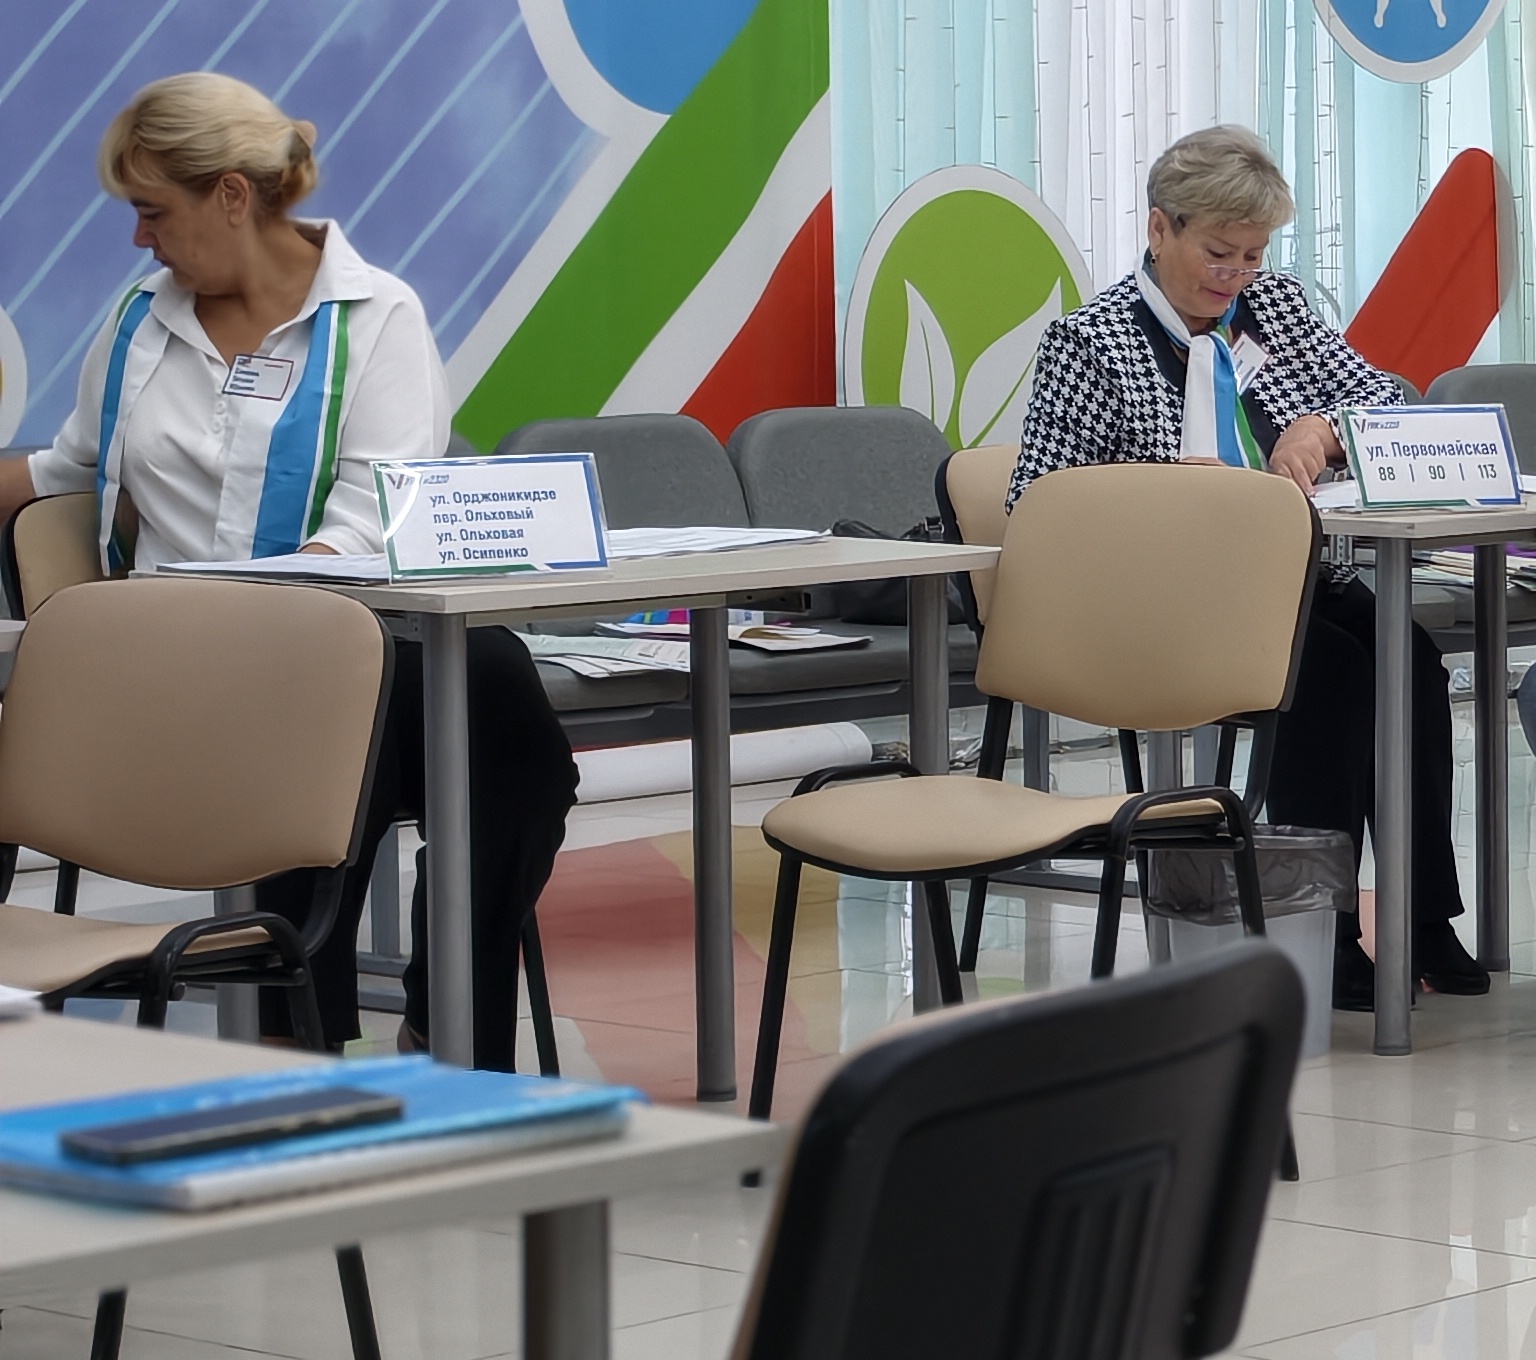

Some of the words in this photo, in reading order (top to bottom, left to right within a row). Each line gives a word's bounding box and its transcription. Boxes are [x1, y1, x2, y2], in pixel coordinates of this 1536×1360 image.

[1366, 445, 1389, 462] ул.
[1391, 439, 1498, 460] Первомайская
[1378, 465, 1396, 481] 88
[1428, 464, 1446, 480] 90
[1477, 463, 1497, 479] 113
[429, 493, 451, 508] ул.
[452, 488, 557, 508] Орджоникидзе
[433, 511, 462, 526] пер.
[464, 506, 535, 523] Ольховый
[436, 531, 457, 546] ул.
[459, 526, 525, 542] Ольховая
[438, 550, 460, 565] ул.
[462, 546, 530, 561] Осипенко
